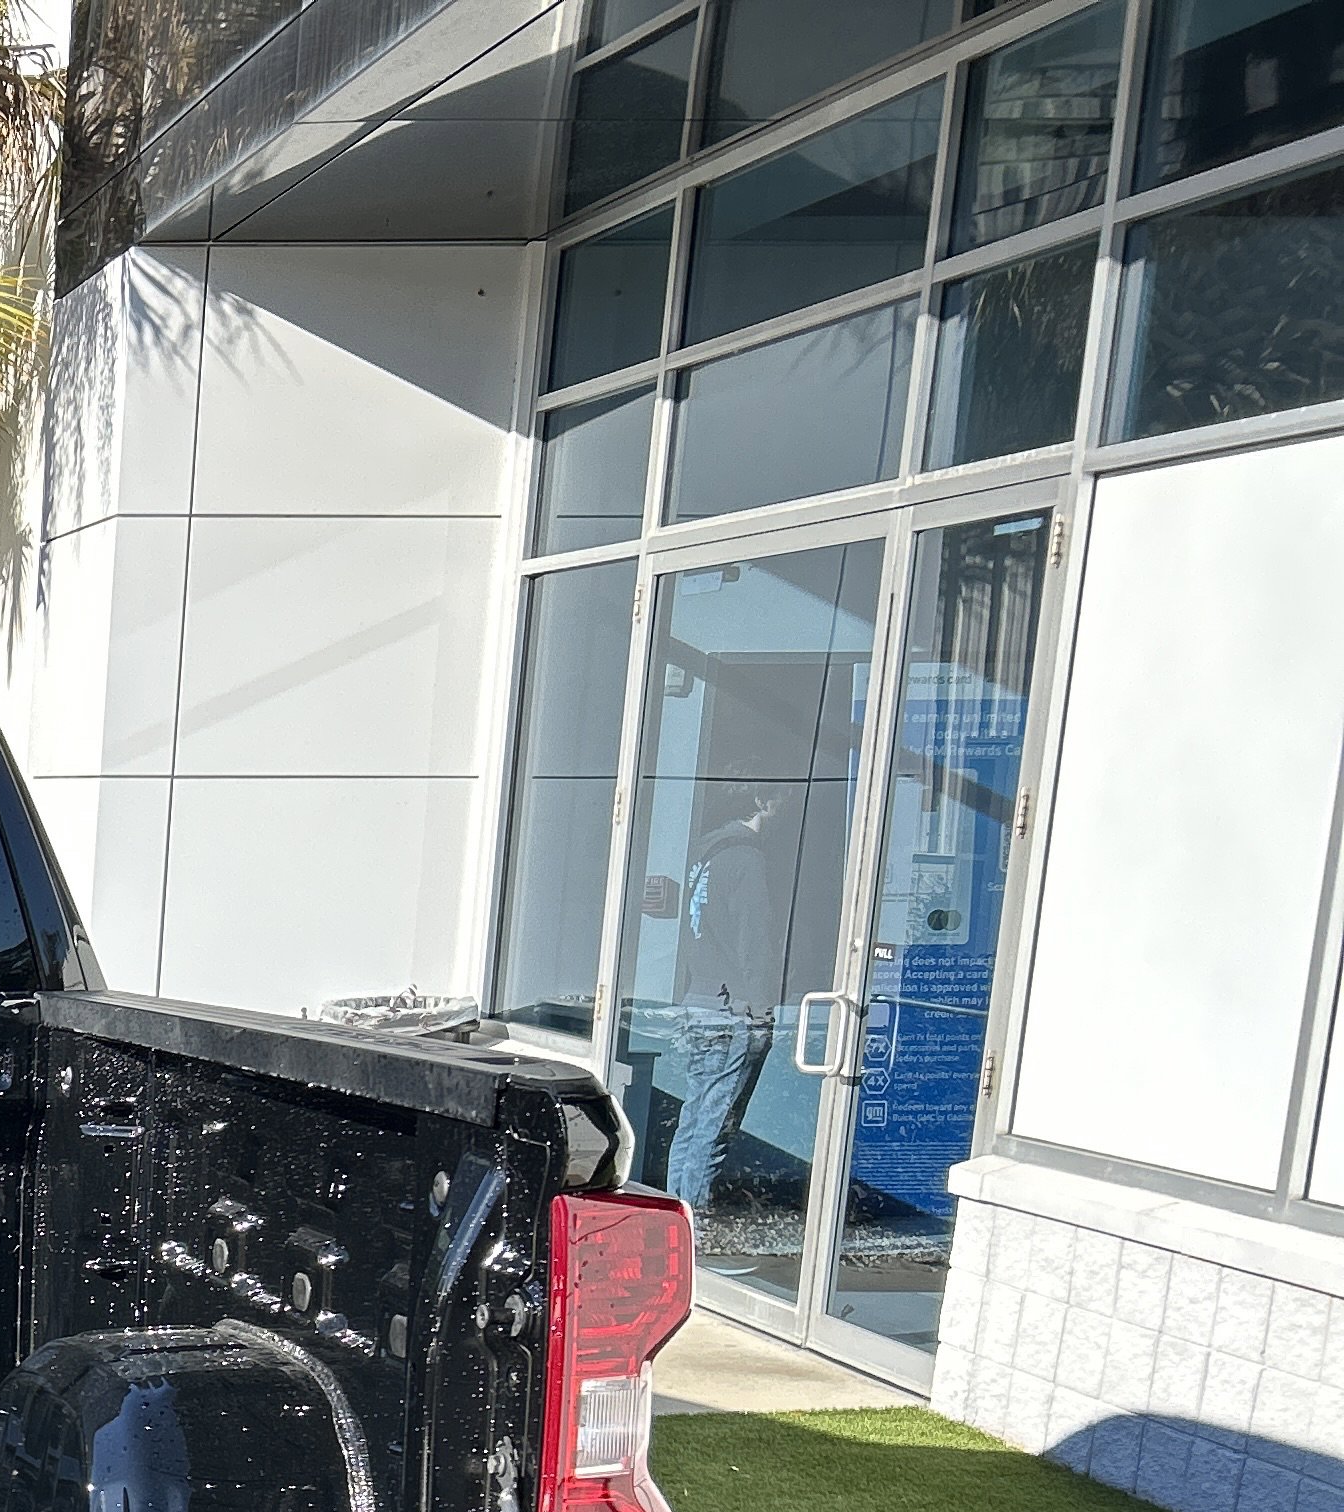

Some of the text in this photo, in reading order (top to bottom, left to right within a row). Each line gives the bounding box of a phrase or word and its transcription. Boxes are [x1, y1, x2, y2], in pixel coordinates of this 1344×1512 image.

[1005, 744, 1021, 756] Ca
[874, 948, 894, 959] PULL
[912, 957, 937, 966] does
[938, 957, 956, 966] not
[904, 970, 955, 981] Accepting
[966, 970, 989, 979] card
[920, 983, 929, 992] is
[931, 983, 978, 994] approved
[962, 997, 983, 1007] may
[867, 1076, 885, 1086] 4X
